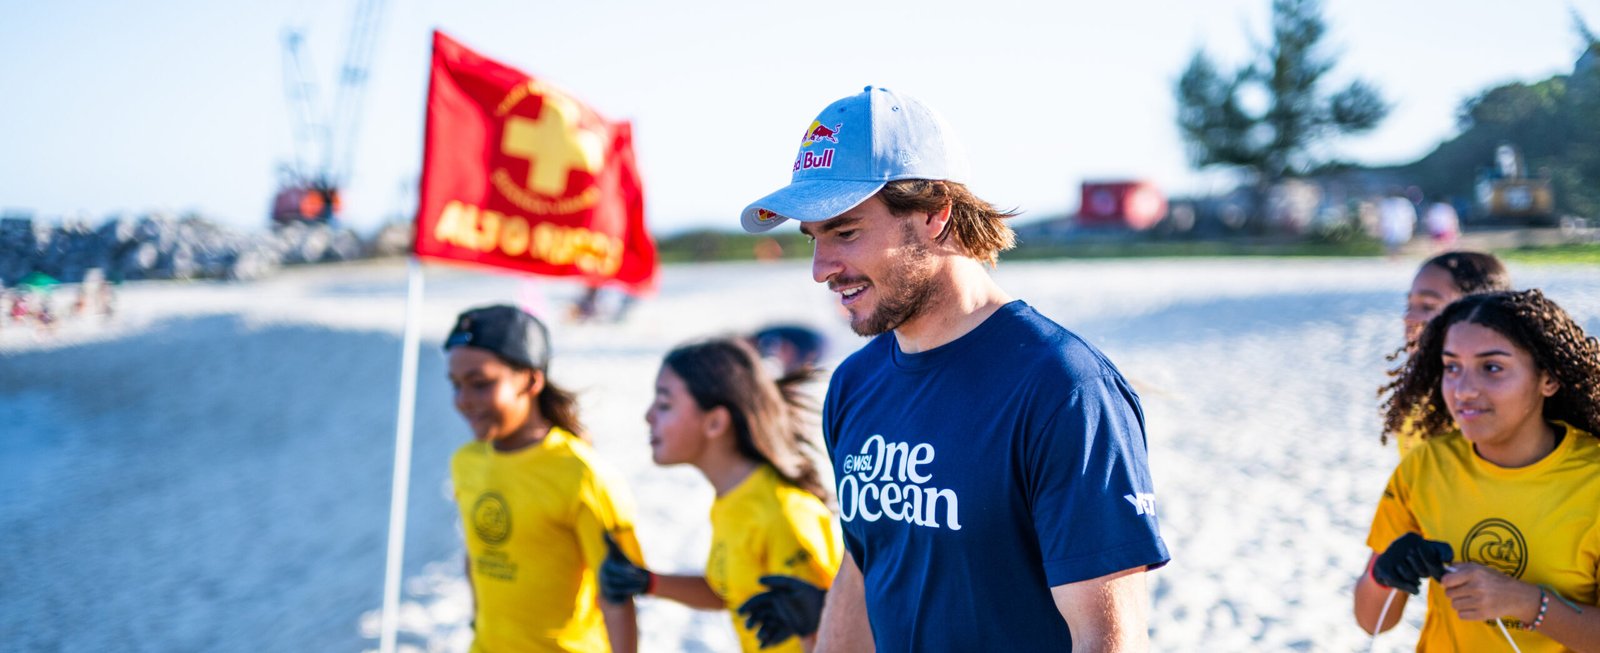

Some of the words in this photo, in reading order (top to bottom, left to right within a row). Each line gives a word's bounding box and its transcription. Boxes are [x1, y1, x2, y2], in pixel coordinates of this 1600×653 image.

[803, 148, 834, 169] Bull
[853, 454, 873, 472] WSL
[858, 434, 936, 484] One
[838, 474, 962, 531] Ocean
